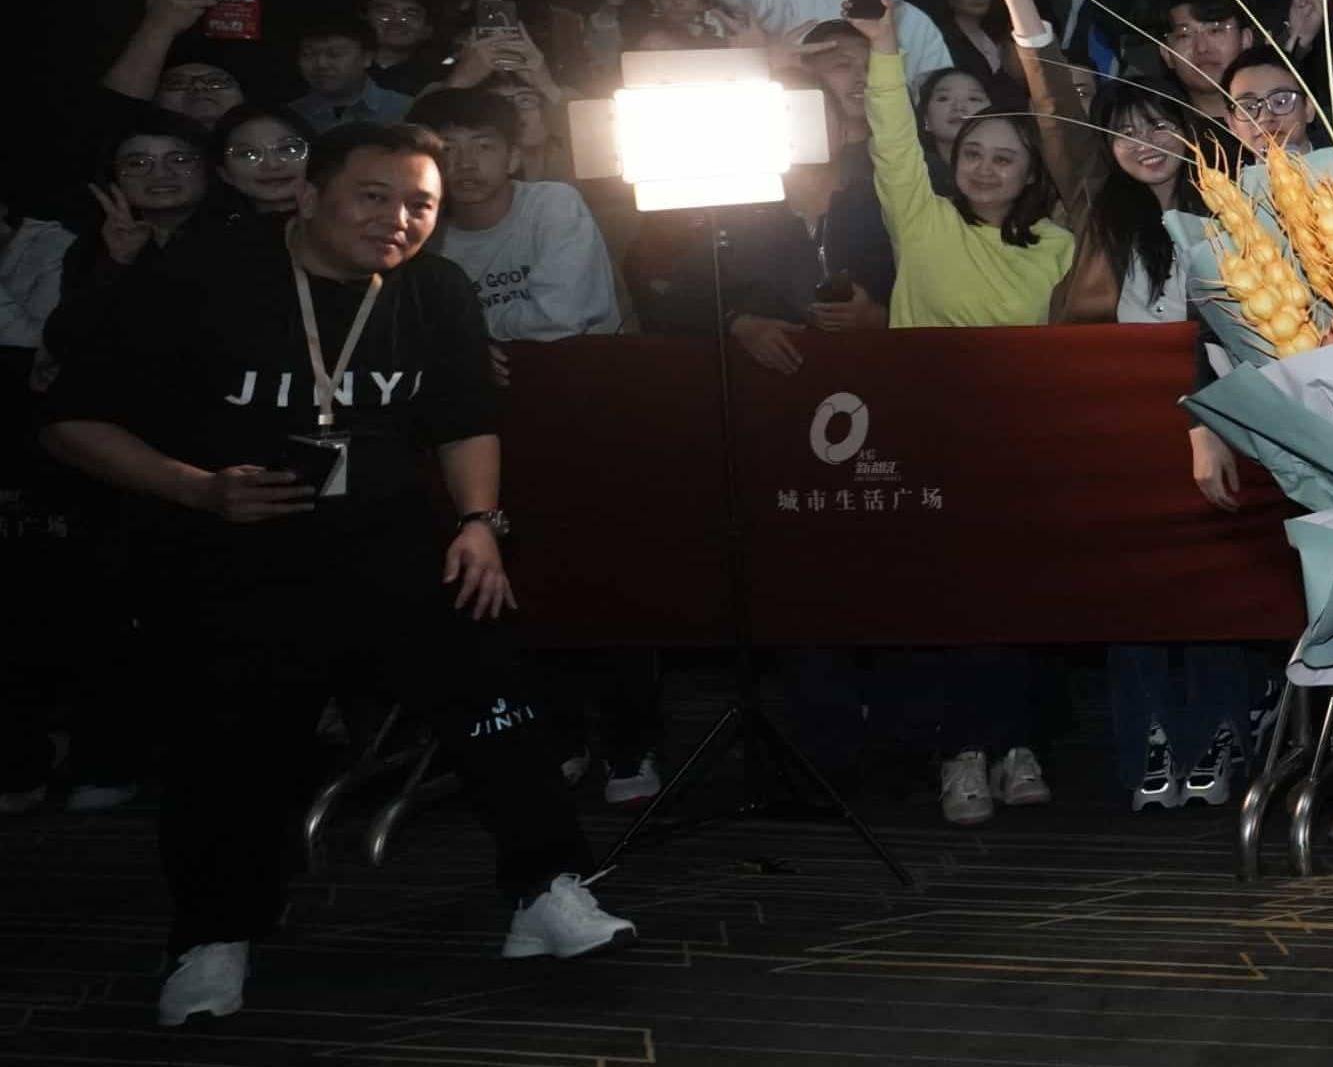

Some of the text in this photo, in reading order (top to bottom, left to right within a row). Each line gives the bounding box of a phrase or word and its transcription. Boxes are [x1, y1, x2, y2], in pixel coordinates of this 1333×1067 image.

[776, 486, 944, 512] 城市生活广场
